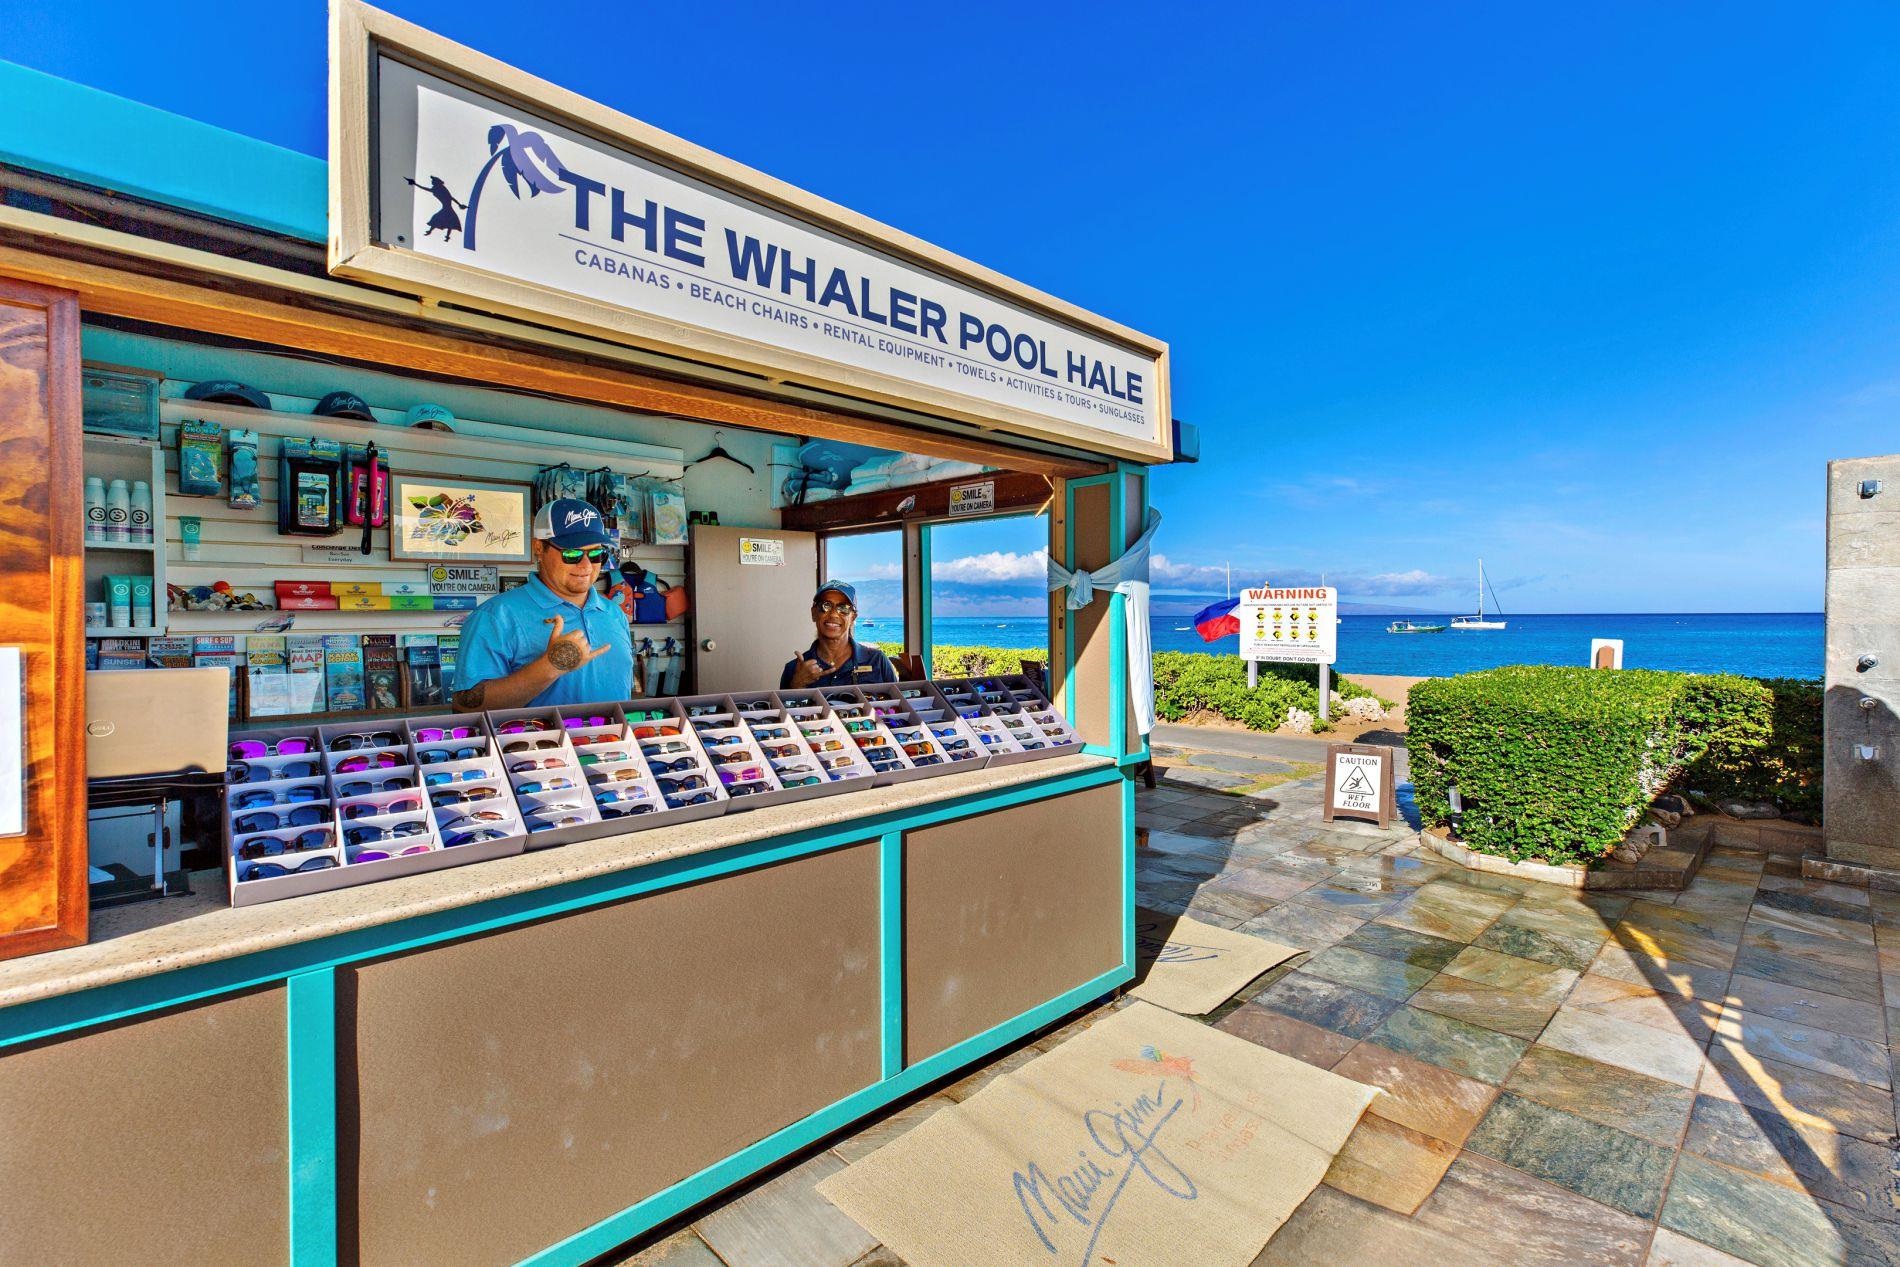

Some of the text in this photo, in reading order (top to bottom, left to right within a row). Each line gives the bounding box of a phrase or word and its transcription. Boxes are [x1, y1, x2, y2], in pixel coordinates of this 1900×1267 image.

[558, 167, 1144, 405] THE WHALER POOL HALE
[575, 250, 1145, 425] CABANAS BEACH CHAIRS RENTAL EQUIPMENT TOWELS ACTIVITIES & TOURS SUNGLASSES
[962, 488, 982, 501] SMILE
[951, 503, 967, 512] YOU'RE
[973, 500, 992, 510] CAMERA
[752, 543, 772, 553] SMILE
[448, 569, 480, 581] SMILE
[432, 583, 456, 591] YOU'RE
[456, 583, 467, 591] ON
[467, 583, 496, 592] CAMERA
[1248, 588, 1327, 600] WARNING
[196, 636, 213, 644] SURF
[220, 636, 233, 644] SUP
[292, 653, 323, 663] MAP
[1339, 756, 1378, 766] CAUTION
[1342, 800, 1371, 809] FLOOR
[1013, 1150, 1114, 1254] Maui
[1084, 1080, 1199, 1200] Jim
